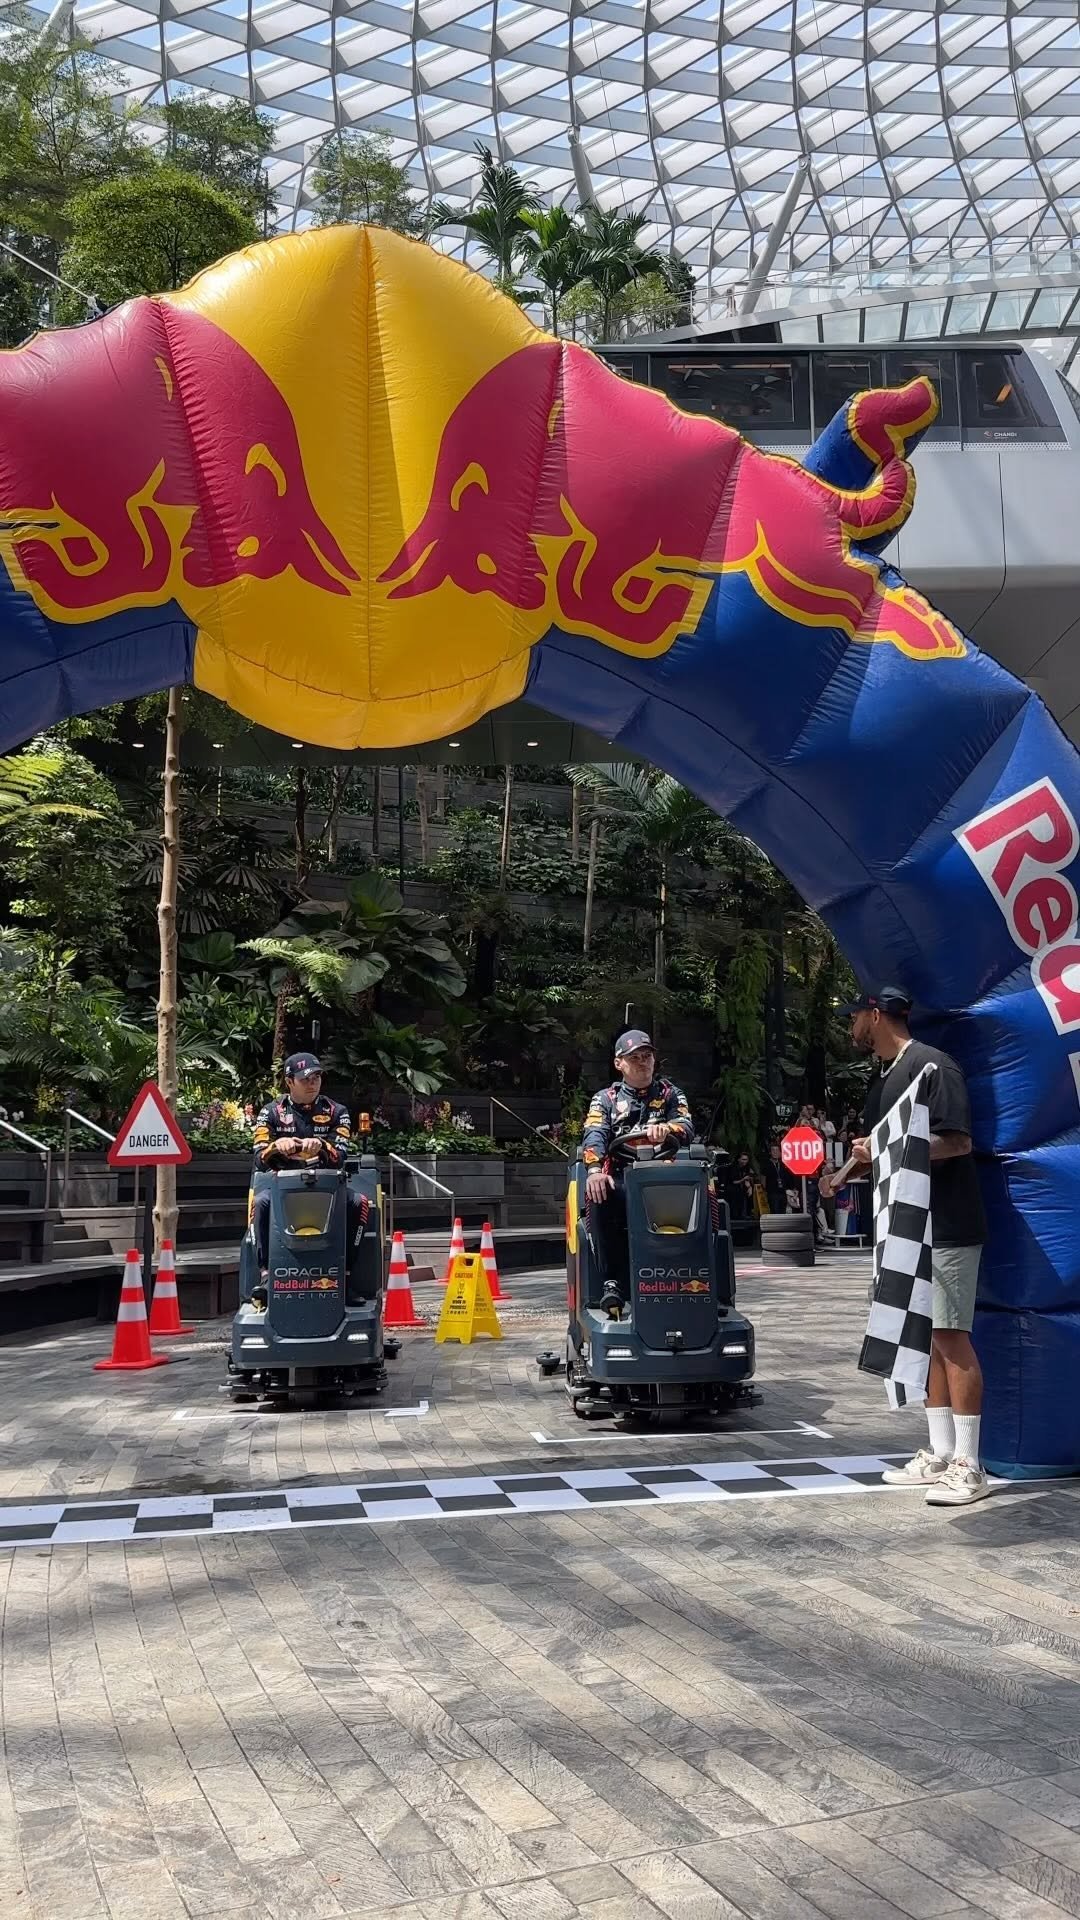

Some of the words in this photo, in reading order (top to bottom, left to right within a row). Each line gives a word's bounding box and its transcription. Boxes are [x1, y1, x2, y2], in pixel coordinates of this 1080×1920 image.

[611, 1123, 650, 1135] ORA
[129, 1134, 169, 1148] DANGER
[782, 1141, 821, 1161] STOP
[274, 1267, 339, 1278] ORACLE
[639, 1267, 709, 1279] ORACLE
